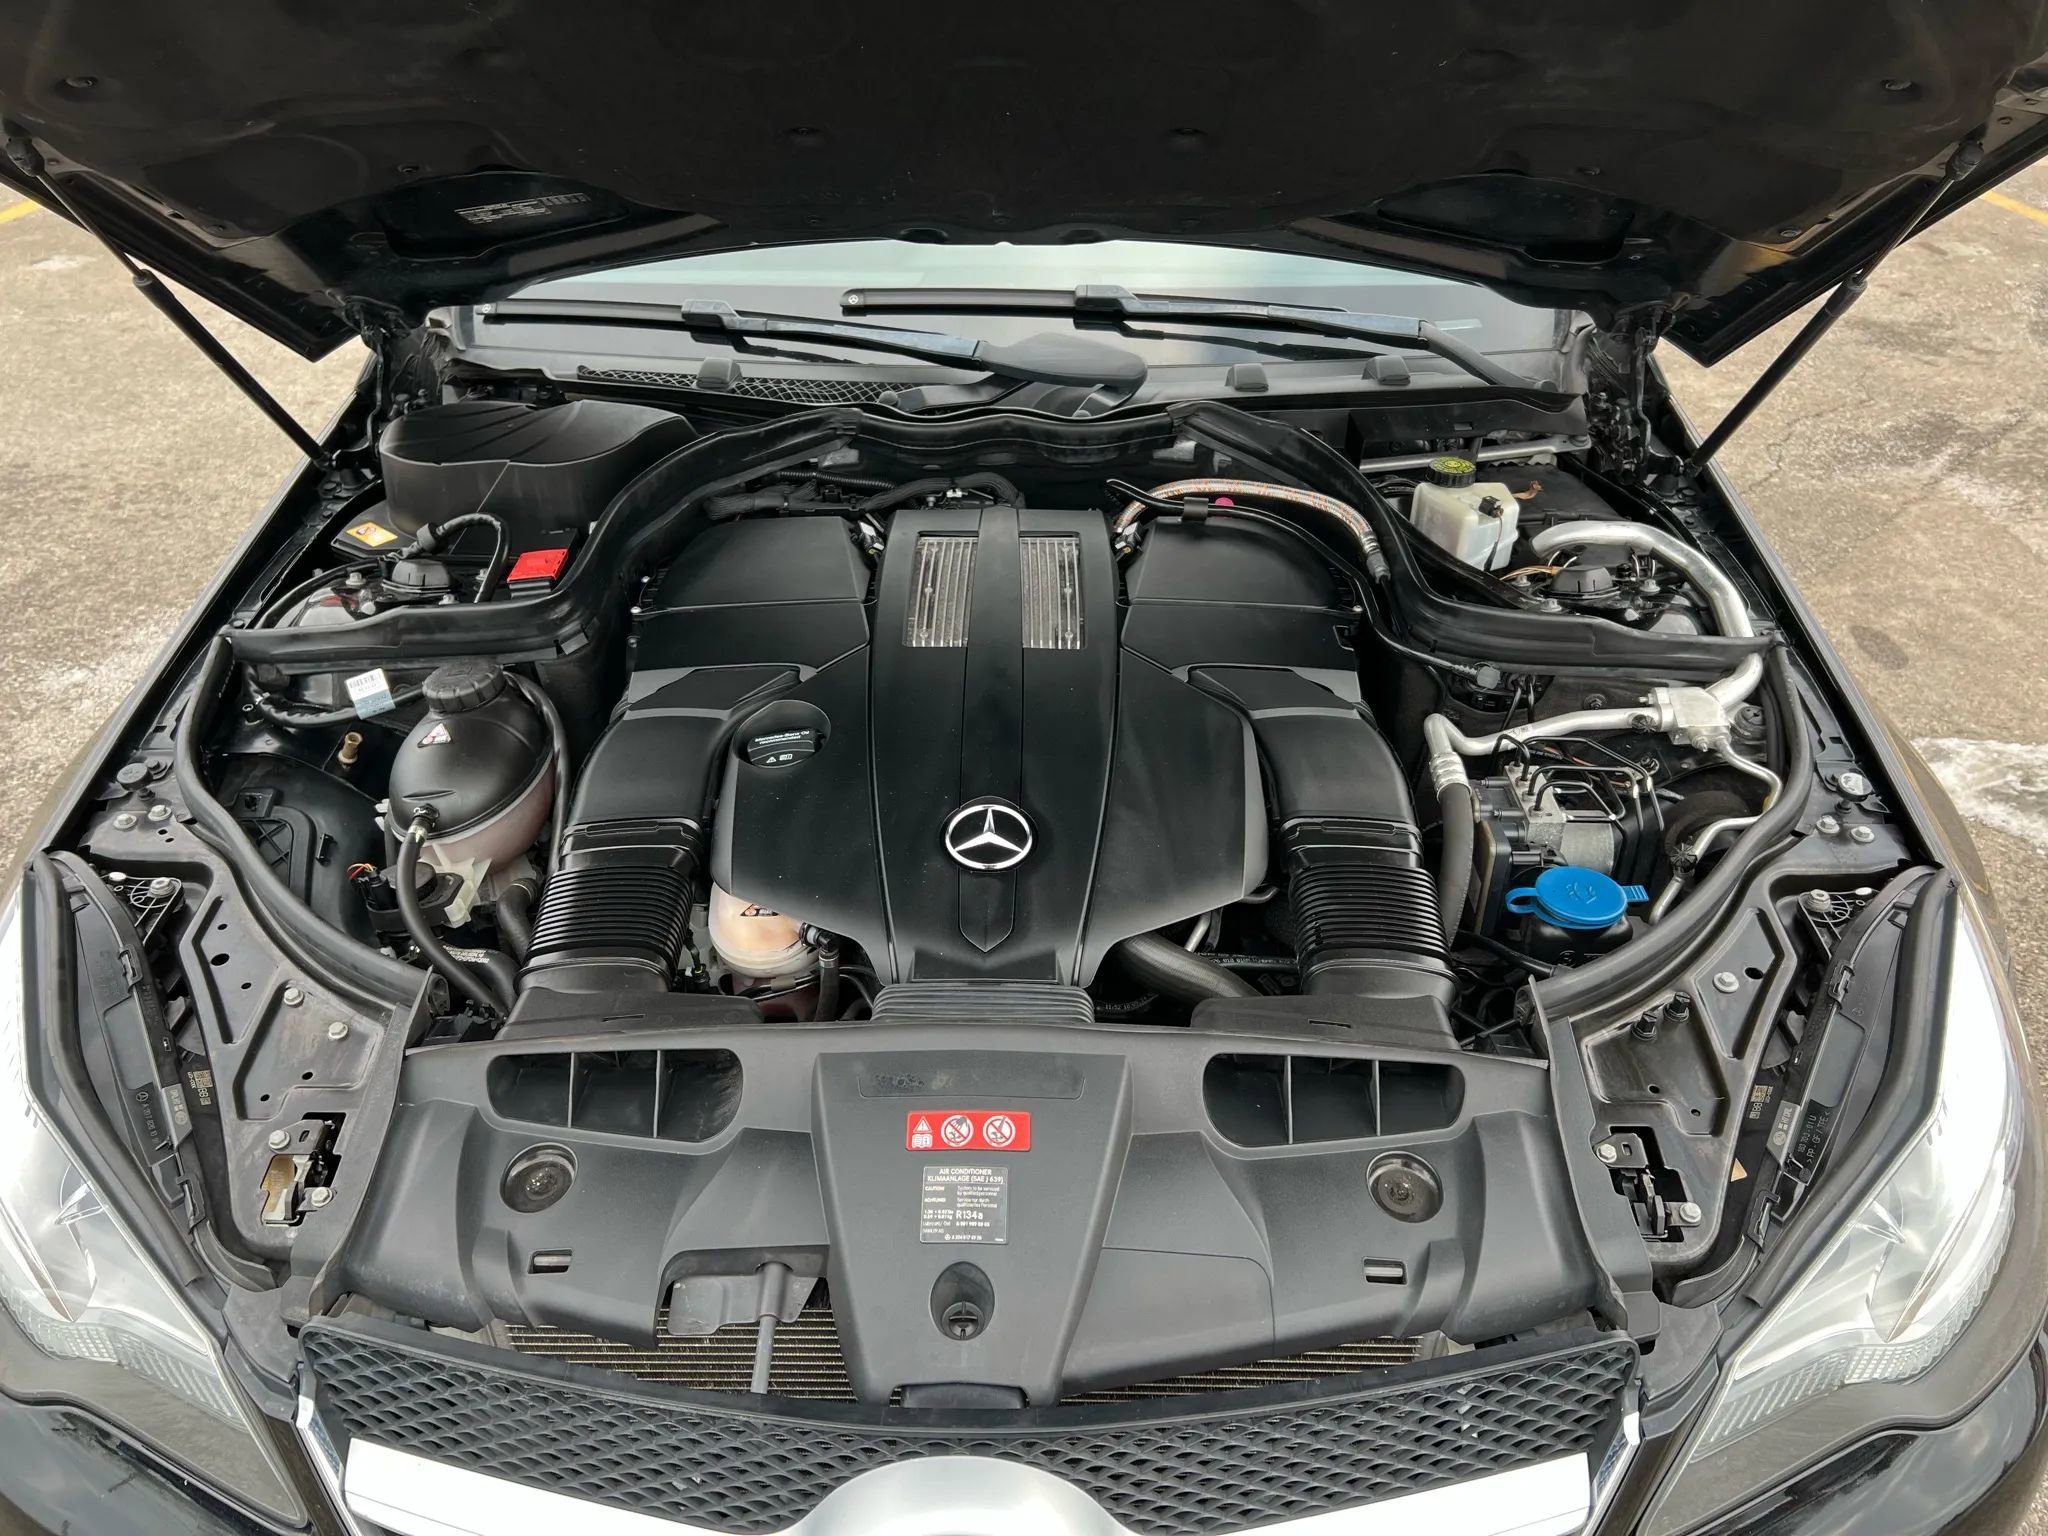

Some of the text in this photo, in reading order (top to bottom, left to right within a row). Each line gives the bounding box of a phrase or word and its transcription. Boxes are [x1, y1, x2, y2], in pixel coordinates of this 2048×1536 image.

[950, 1168, 992, 1176] CONDITIONER
[970, 1175, 985, 1183] (SAE
[989, 1176, 1004, 1185] 639)
[956, 1209, 984, 1220] R134a
